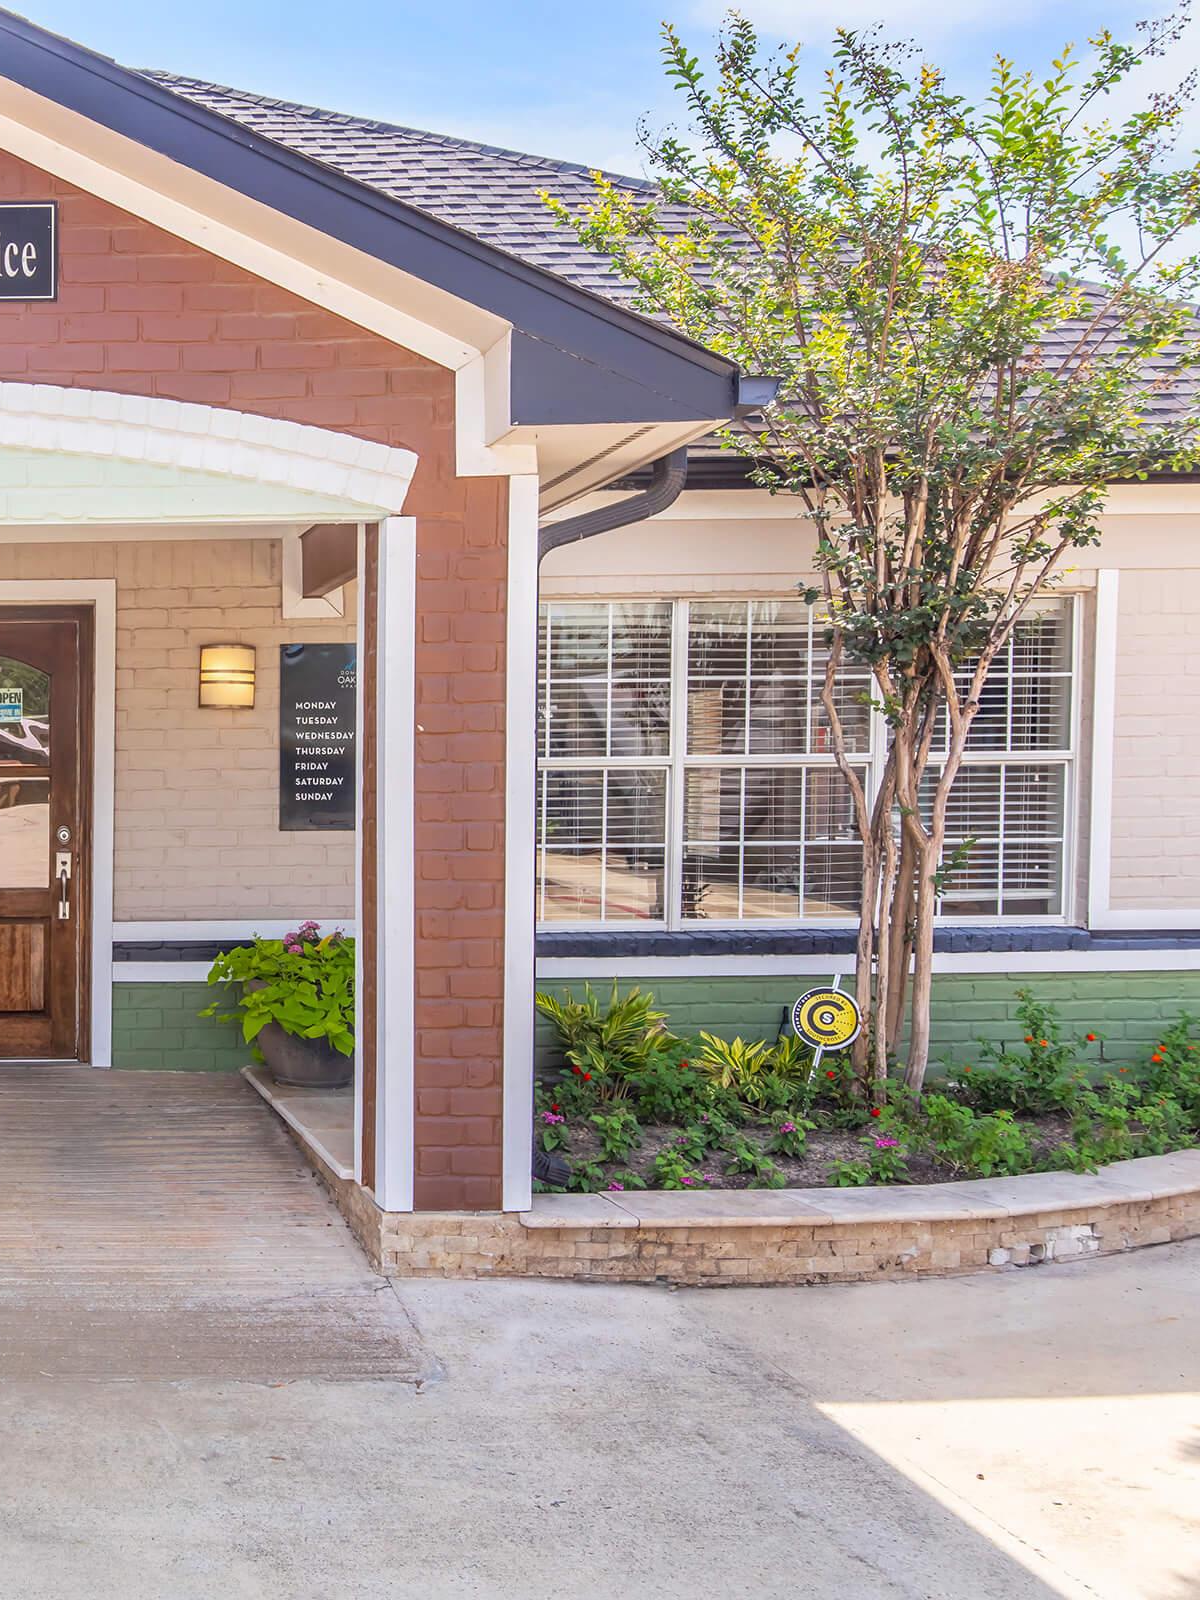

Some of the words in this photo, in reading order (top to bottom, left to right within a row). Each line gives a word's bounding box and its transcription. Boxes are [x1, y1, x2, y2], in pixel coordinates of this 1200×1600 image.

[338, 676, 356, 684] OAK
[295, 777, 344, 785] SATURDAY
[822, 1013, 833, 1024] S
